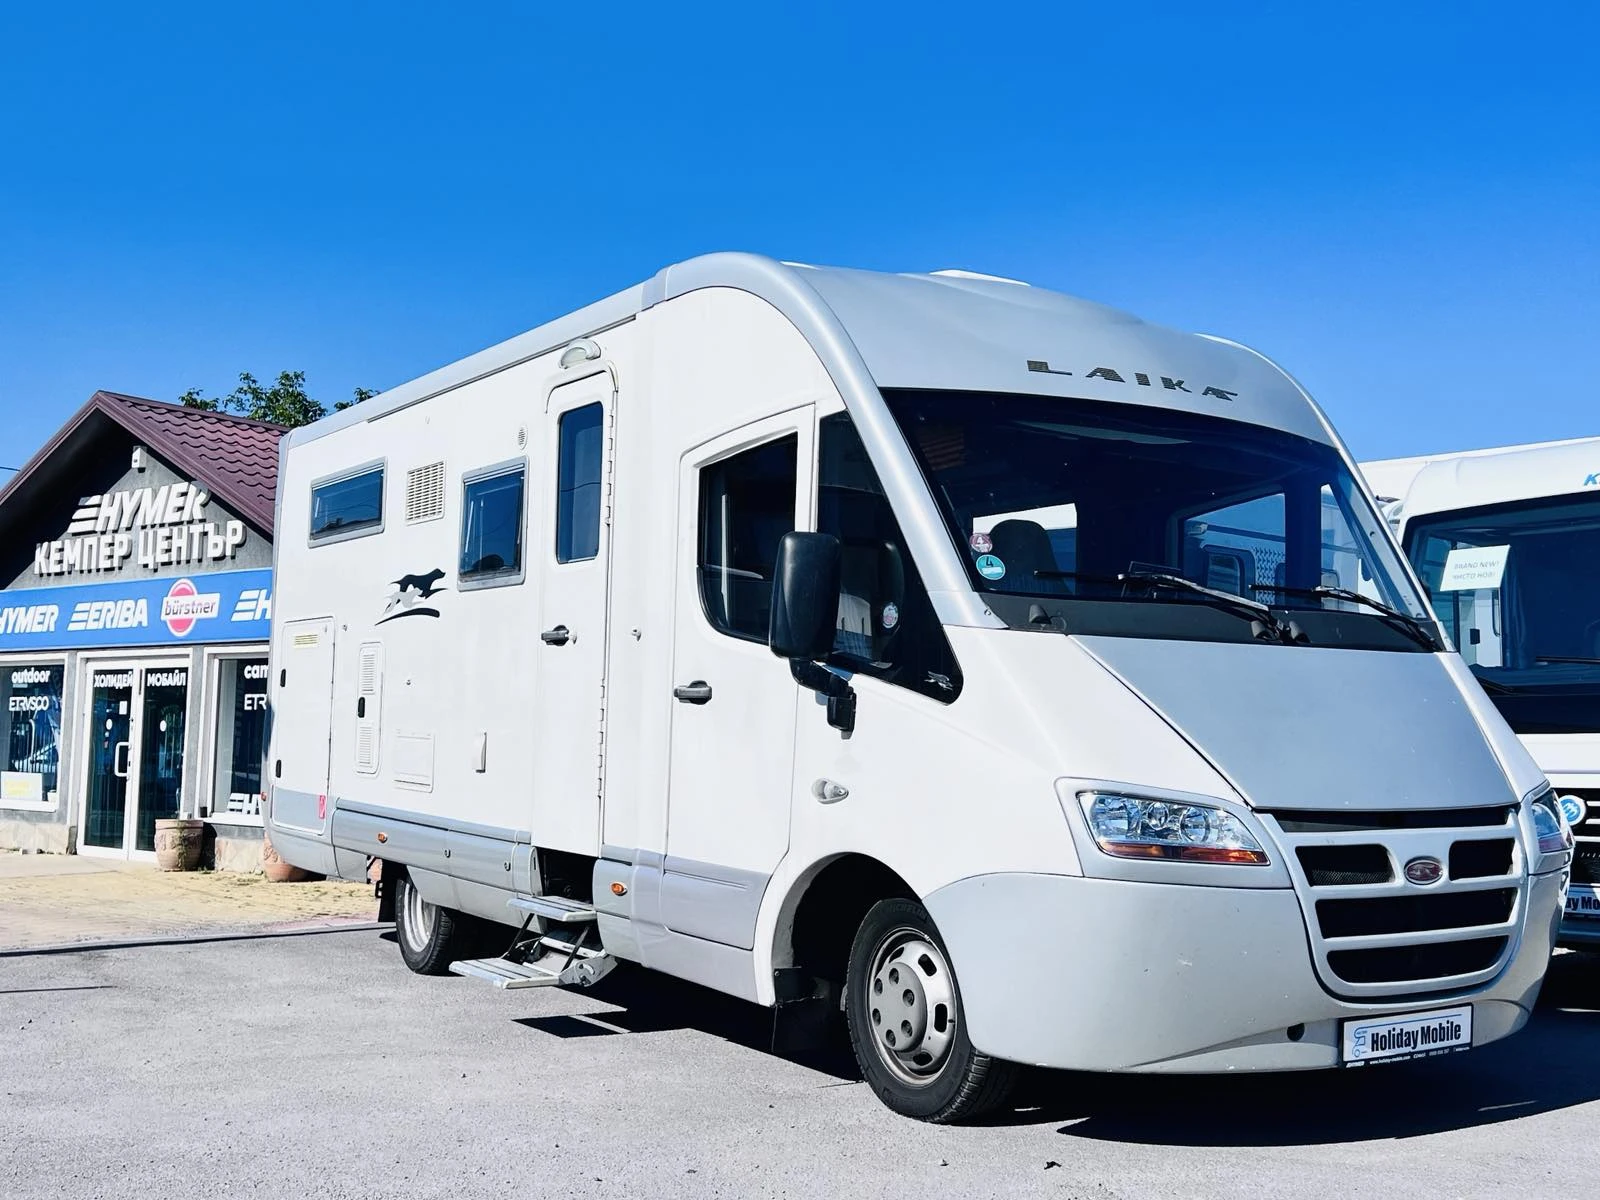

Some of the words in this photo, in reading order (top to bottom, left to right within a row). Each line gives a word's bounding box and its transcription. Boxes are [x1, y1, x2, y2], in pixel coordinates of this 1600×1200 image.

[1027, 360, 1238, 402] LAIKA
[1584, 473, 1600, 486] K
[34, 533, 132, 575] КЕМПЕР
[137, 519, 245, 569] ЦЕНТЪР
[86, 598, 149, 630] ERIBA
[164, 600, 217, 616] bürstner
[11, 667, 51, 684] outdoor
[147, 669, 187, 687] МОБАЙЛ
[1371, 1027, 1419, 1052] Holiday
[1420, 1020, 1462, 1045] Mobile
